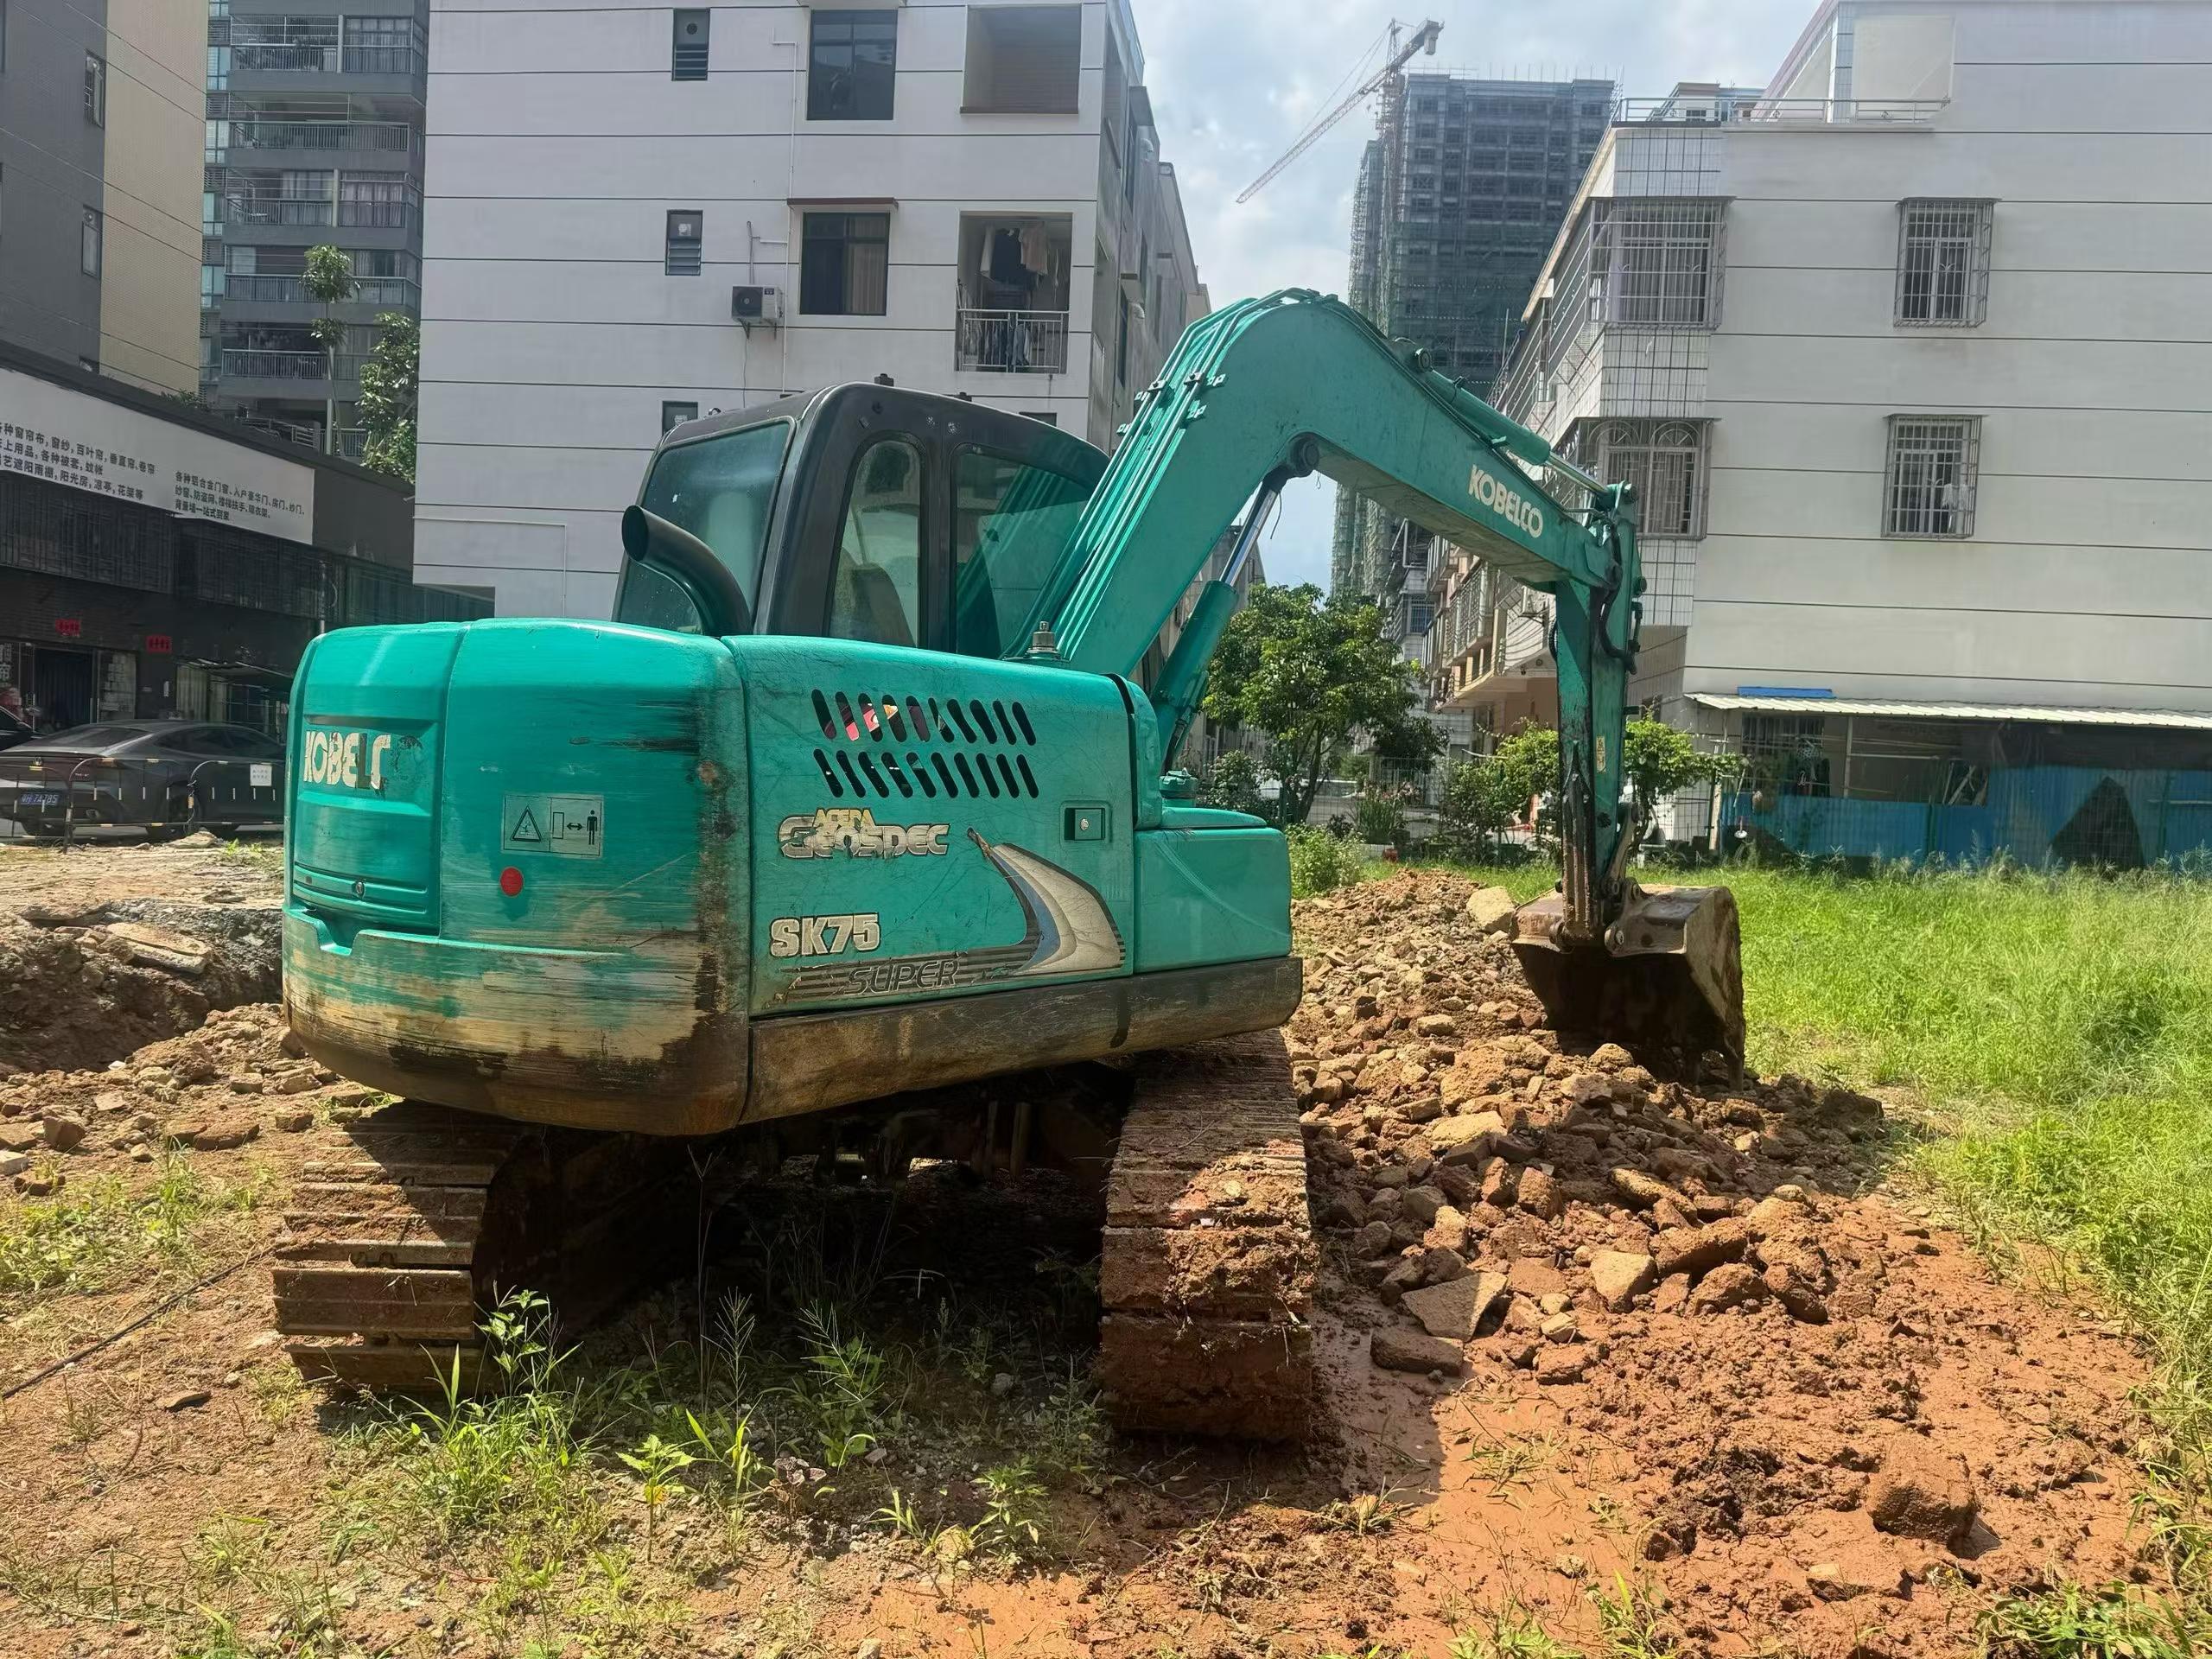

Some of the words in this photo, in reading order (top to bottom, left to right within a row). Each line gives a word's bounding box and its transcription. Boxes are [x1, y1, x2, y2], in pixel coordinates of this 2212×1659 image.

[1468, 464, 1543, 538] KOBELCO
[771, 912, 880, 957] SK75
[842, 960, 958, 996] SUPER
